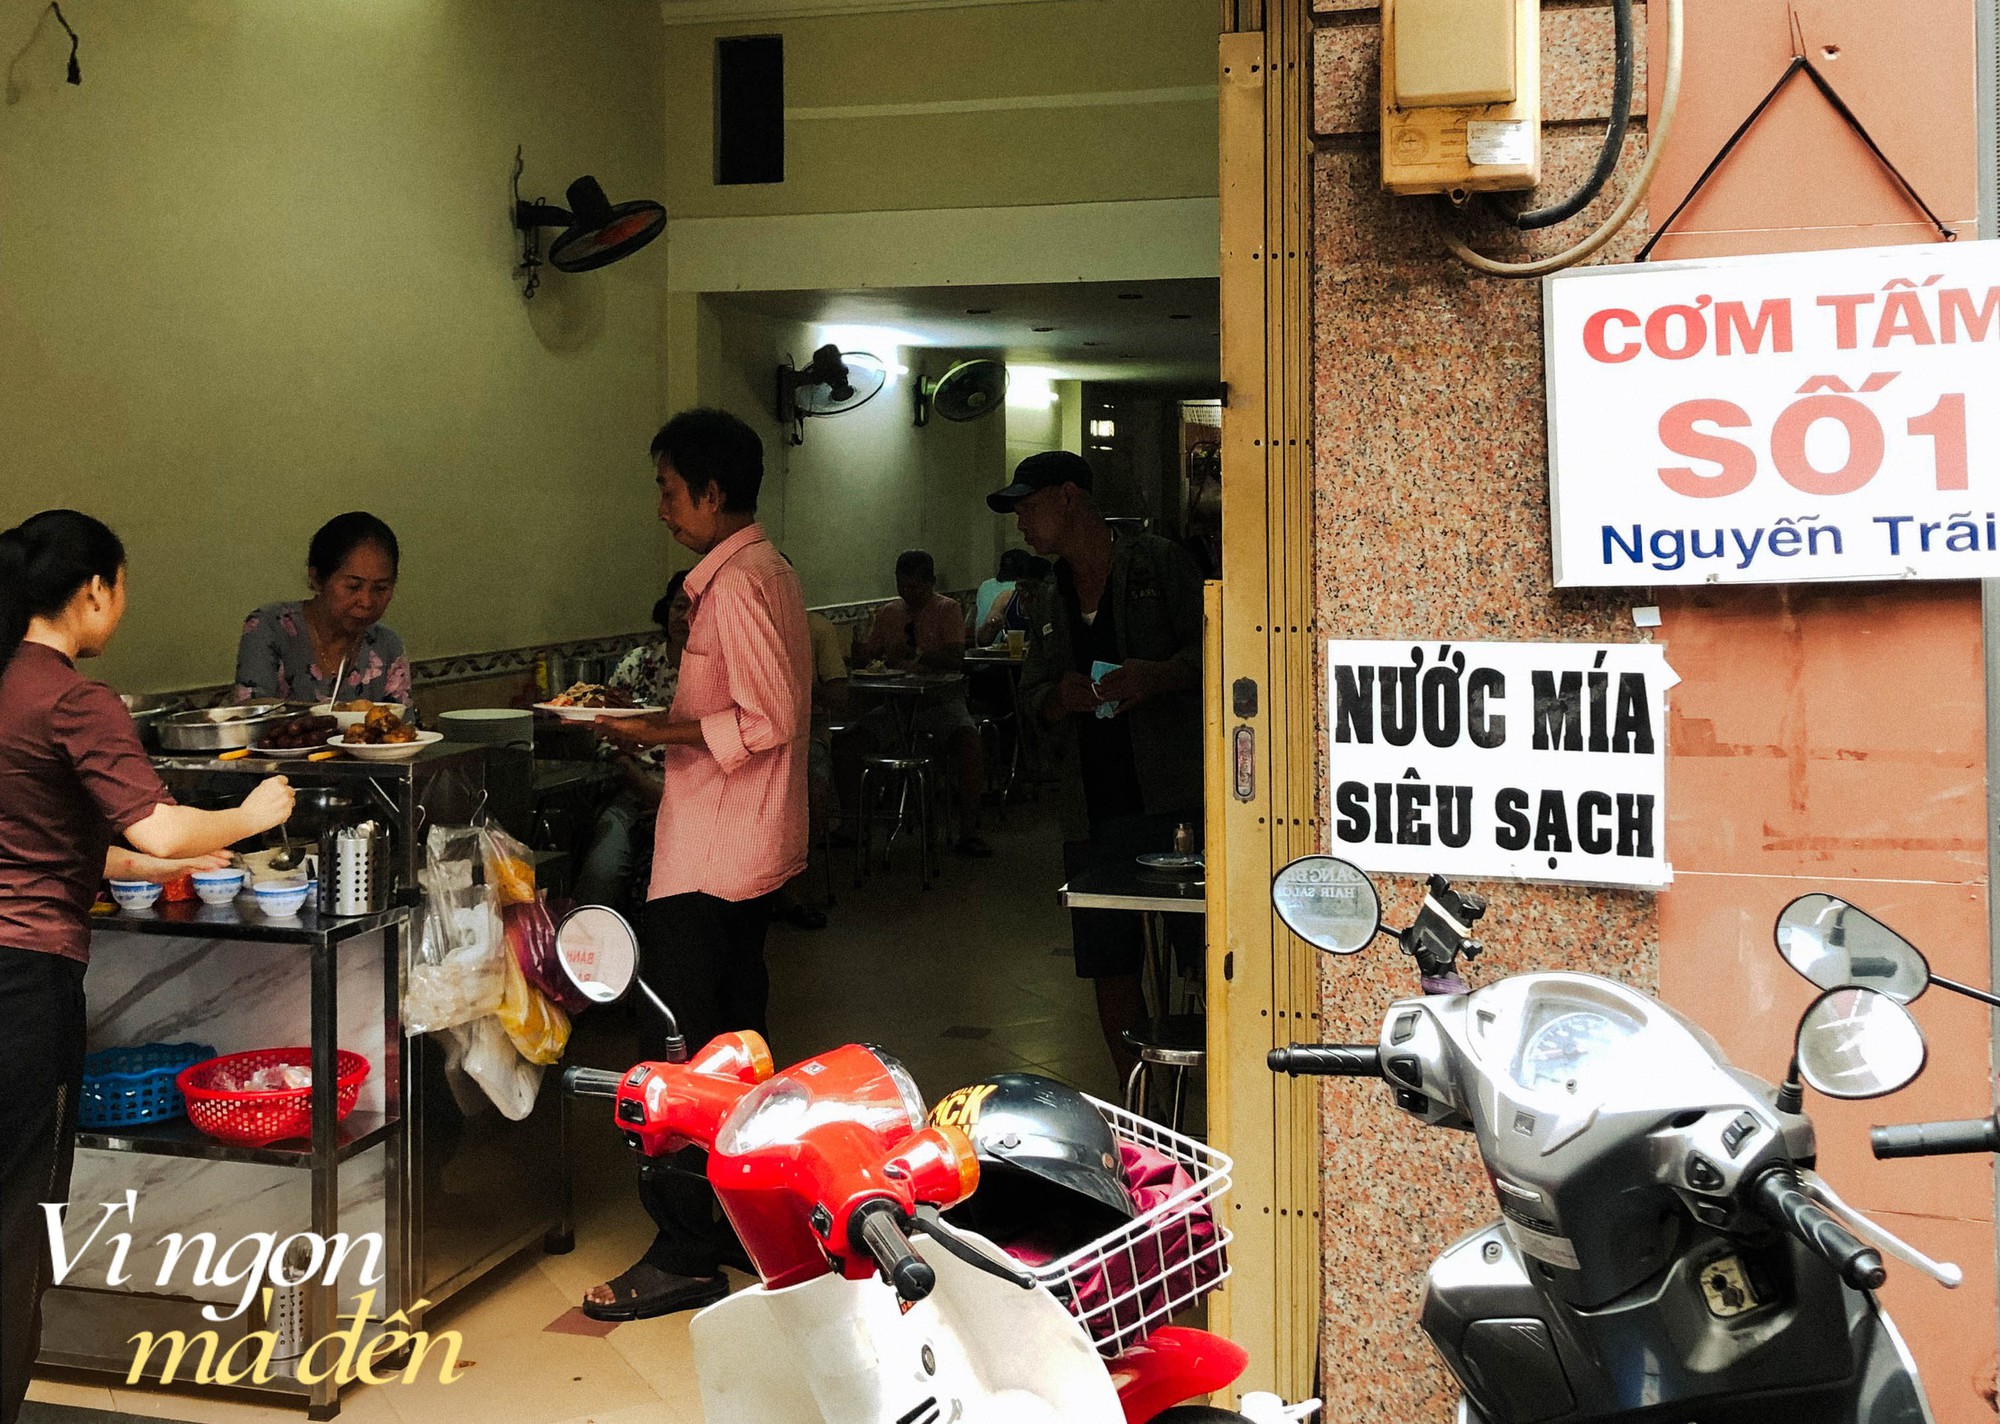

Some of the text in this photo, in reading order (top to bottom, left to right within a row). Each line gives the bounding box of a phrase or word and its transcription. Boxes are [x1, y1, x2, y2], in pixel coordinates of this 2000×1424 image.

[1582, 274, 2000, 363] CƠM TẤM
[1601, 511, 1997, 571] Nguyễn Trãi
[1334, 644, 1655, 755] NƯỚC MÍA
[1336, 767, 1655, 870] SIÊU SẠCH
